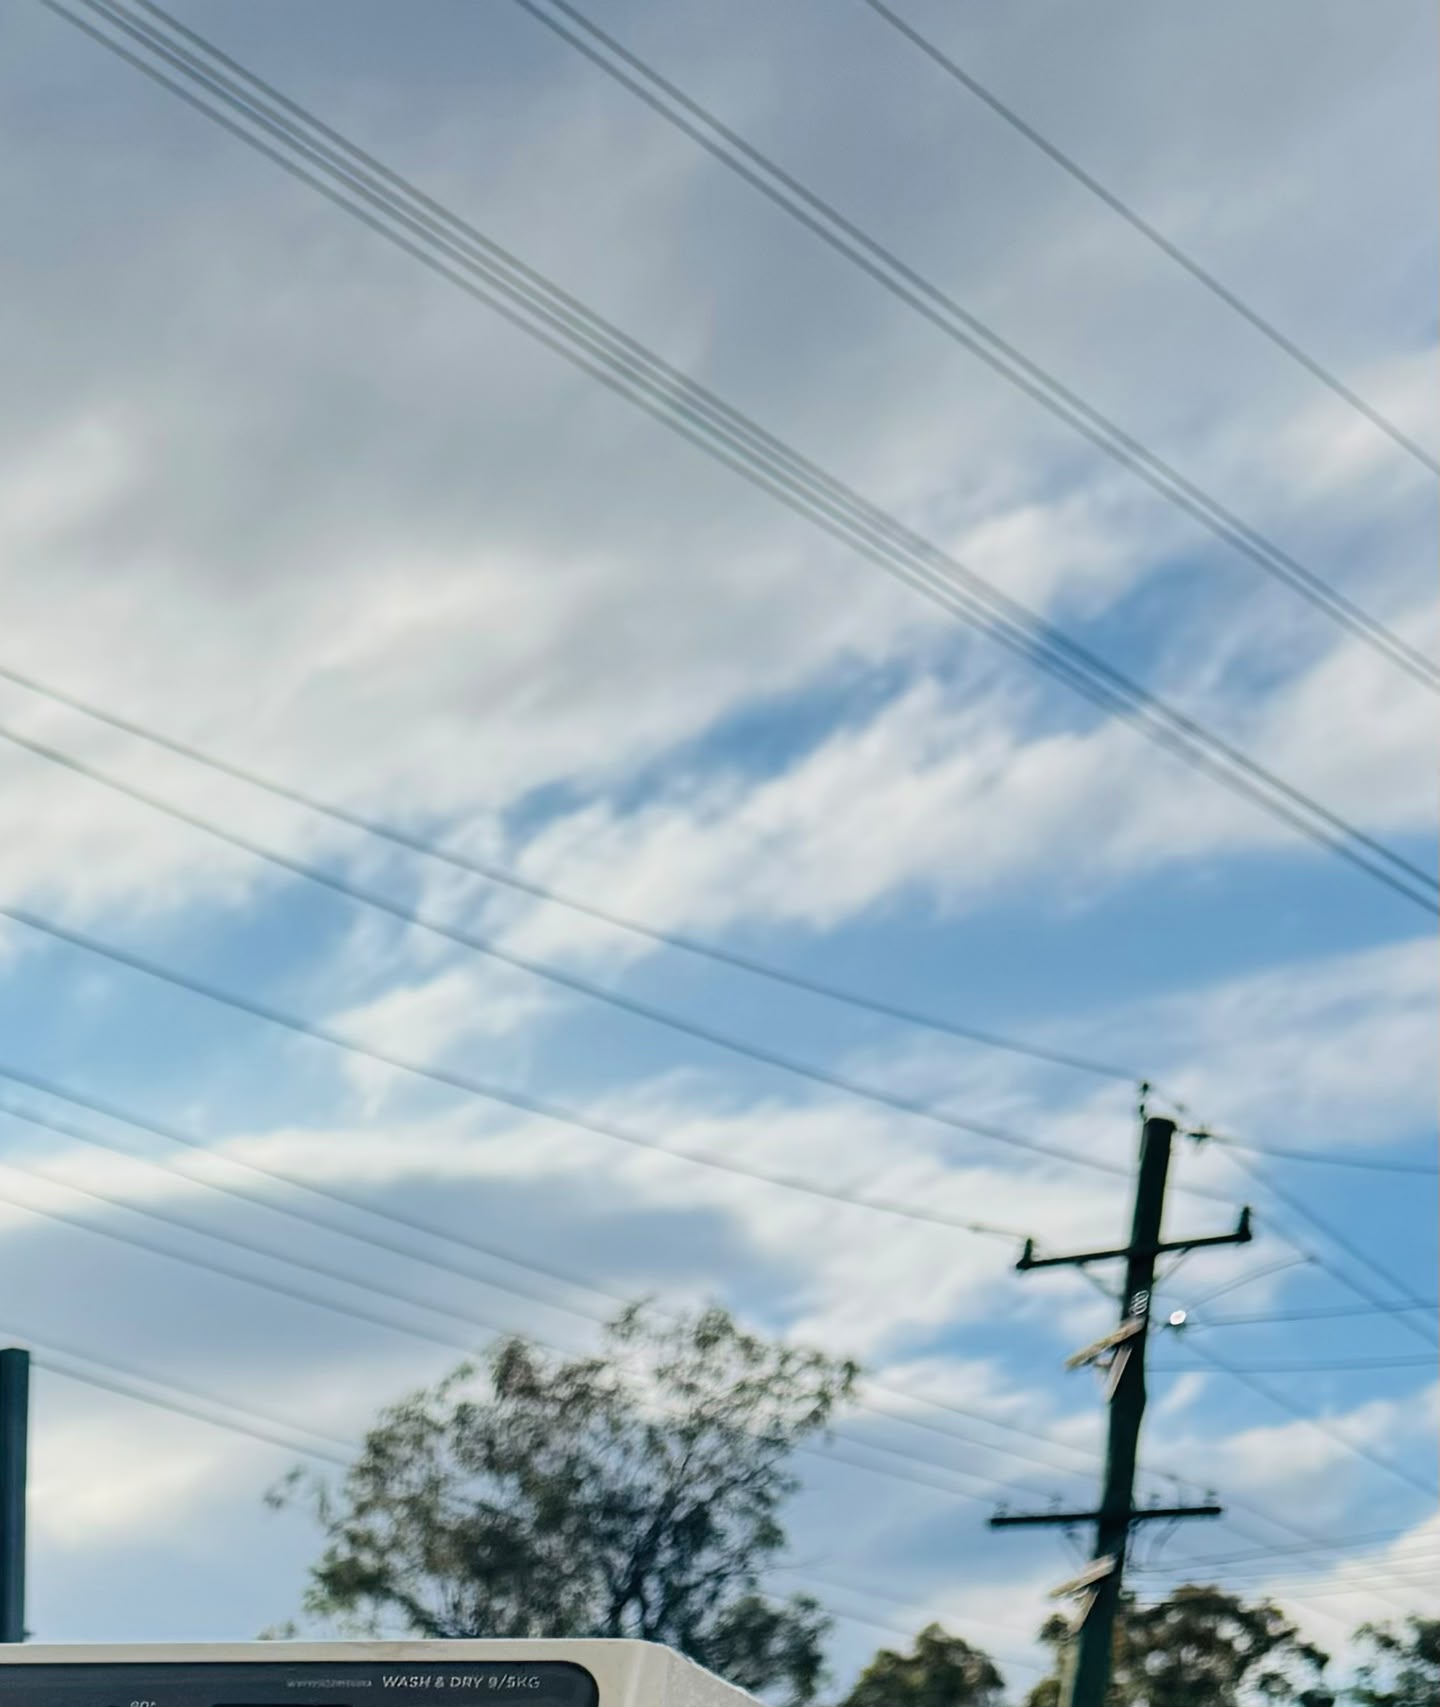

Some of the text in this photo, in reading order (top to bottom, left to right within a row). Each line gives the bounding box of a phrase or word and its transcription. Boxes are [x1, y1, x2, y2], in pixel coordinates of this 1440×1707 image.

[382, 1675, 431, 1689] WASH
[434, 1676, 445, 1689] &
[450, 1676, 482, 1689] DRY
